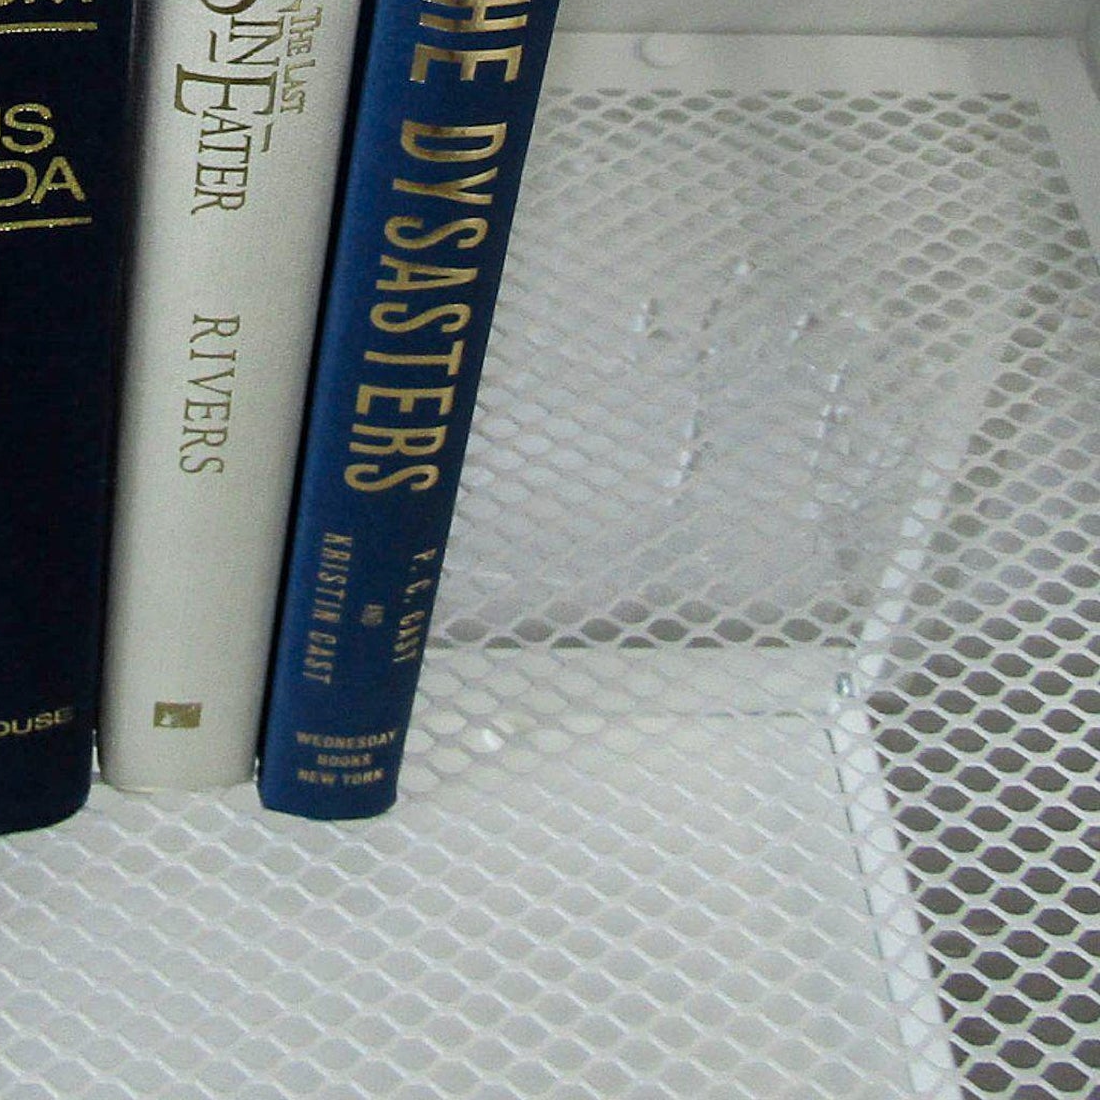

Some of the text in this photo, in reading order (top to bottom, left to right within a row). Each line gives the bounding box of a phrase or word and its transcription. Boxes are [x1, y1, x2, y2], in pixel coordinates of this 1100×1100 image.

[280, 6, 323, 115] THE LAST
[173, 63, 278, 216] EATER
[344, 119, 508, 493] DYSASTERS
[179, 313, 241, 477] RIVERS
[302, 532, 353, 686] KRISTIN CAST
